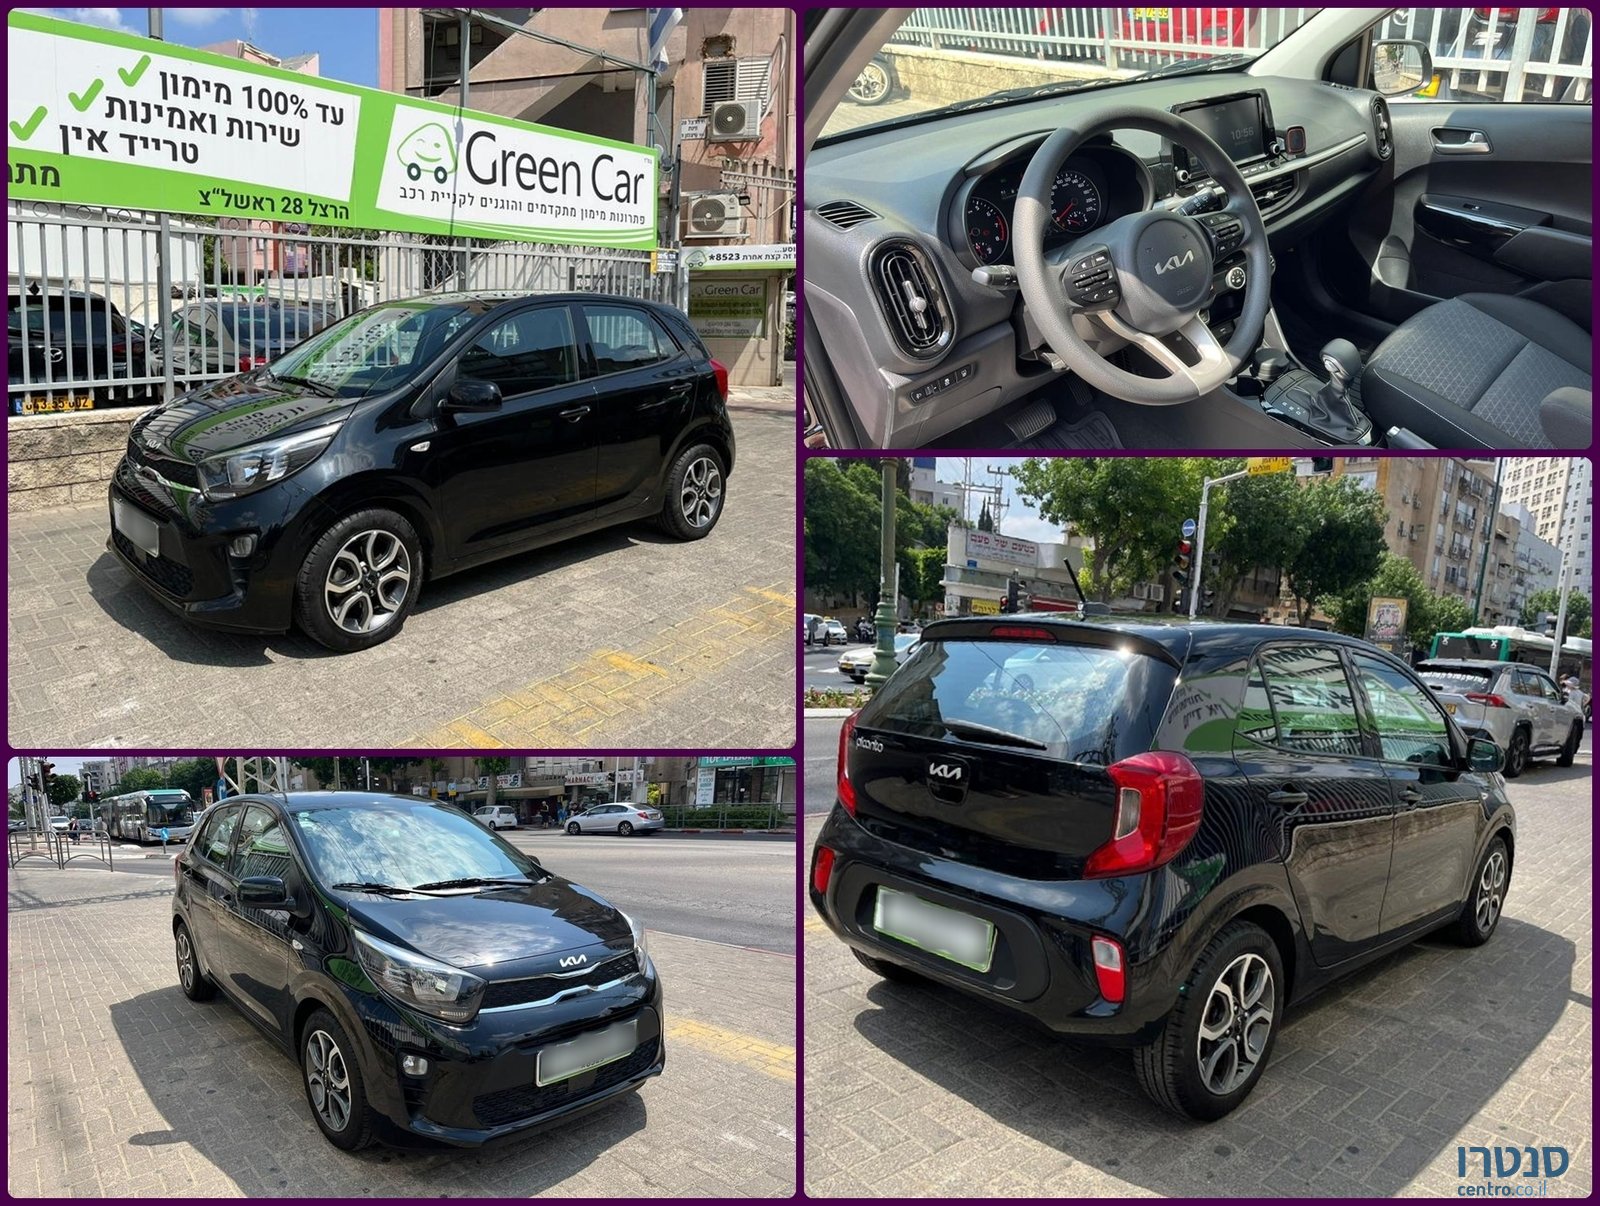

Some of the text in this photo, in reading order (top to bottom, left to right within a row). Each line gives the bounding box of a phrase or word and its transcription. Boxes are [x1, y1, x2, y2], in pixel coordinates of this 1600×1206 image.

[159, 70, 345, 126] עד 100% מימון
[105, 95, 301, 148] שירות ואמינות
[59, 124, 200, 164] טרייד אין
[465, 130, 645, 205] Green Car
[281, 196, 304, 215] 28
[308, 198, 350, 220] הרצל
[399, 186, 646, 225] פתרונות מימון מתקדמים והוגנים לקניית רכב
[765, 253, 781, 261] קצת
[705, 284, 761, 296] Green Car
[856, 736, 884, 753] picanto
